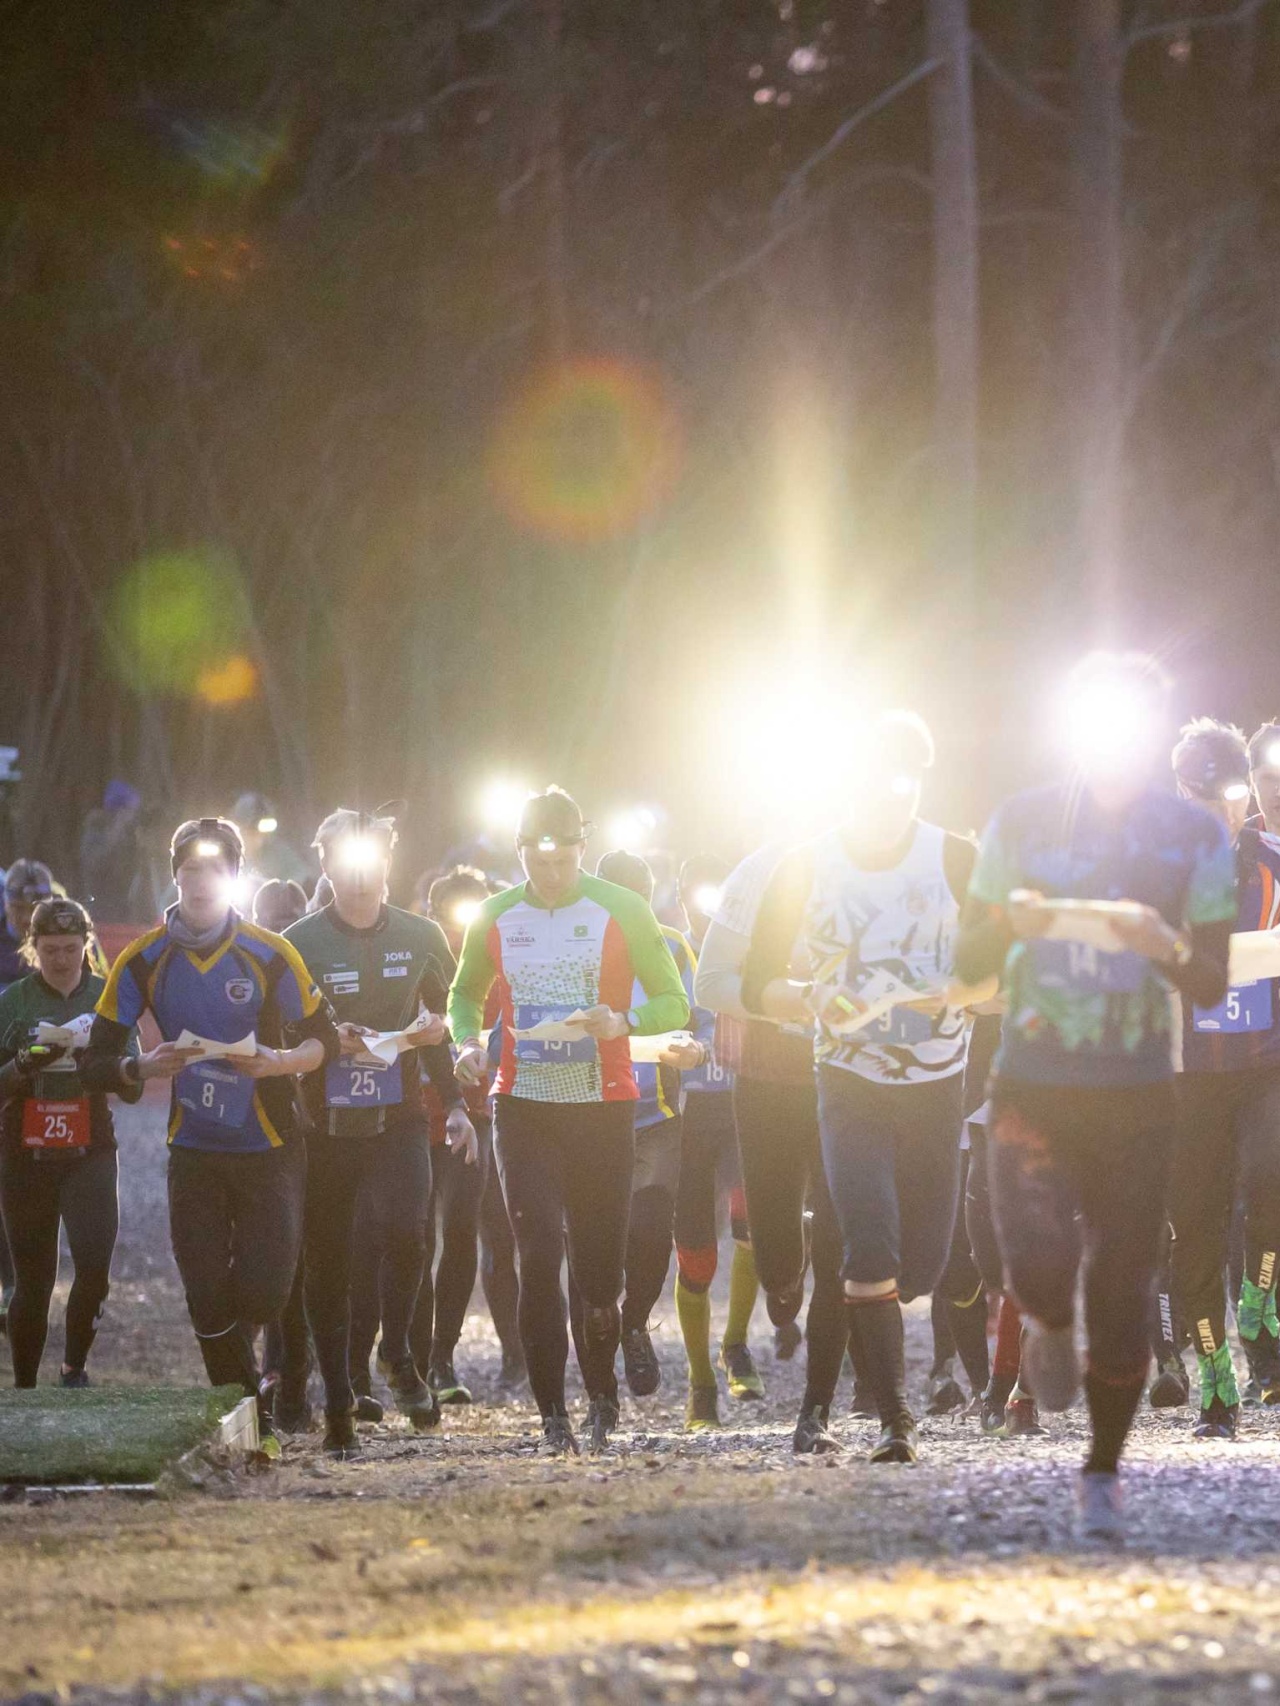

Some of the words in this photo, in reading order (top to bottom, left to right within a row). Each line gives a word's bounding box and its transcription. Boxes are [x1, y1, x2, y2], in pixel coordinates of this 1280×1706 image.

[384, 951, 413, 962] JOKA
[1226, 992, 1240, 1021] 5
[1244, 1010, 1249, 1026] 1
[202, 1082, 215, 1108] 8
[350, 1070, 376, 1096] 25
[377, 1087, 381, 1101] 1
[44, 1115, 68, 1139] 25
[68, 1130, 74, 1143] 2
[1158, 1293, 1173, 1343] TRIMTEX
